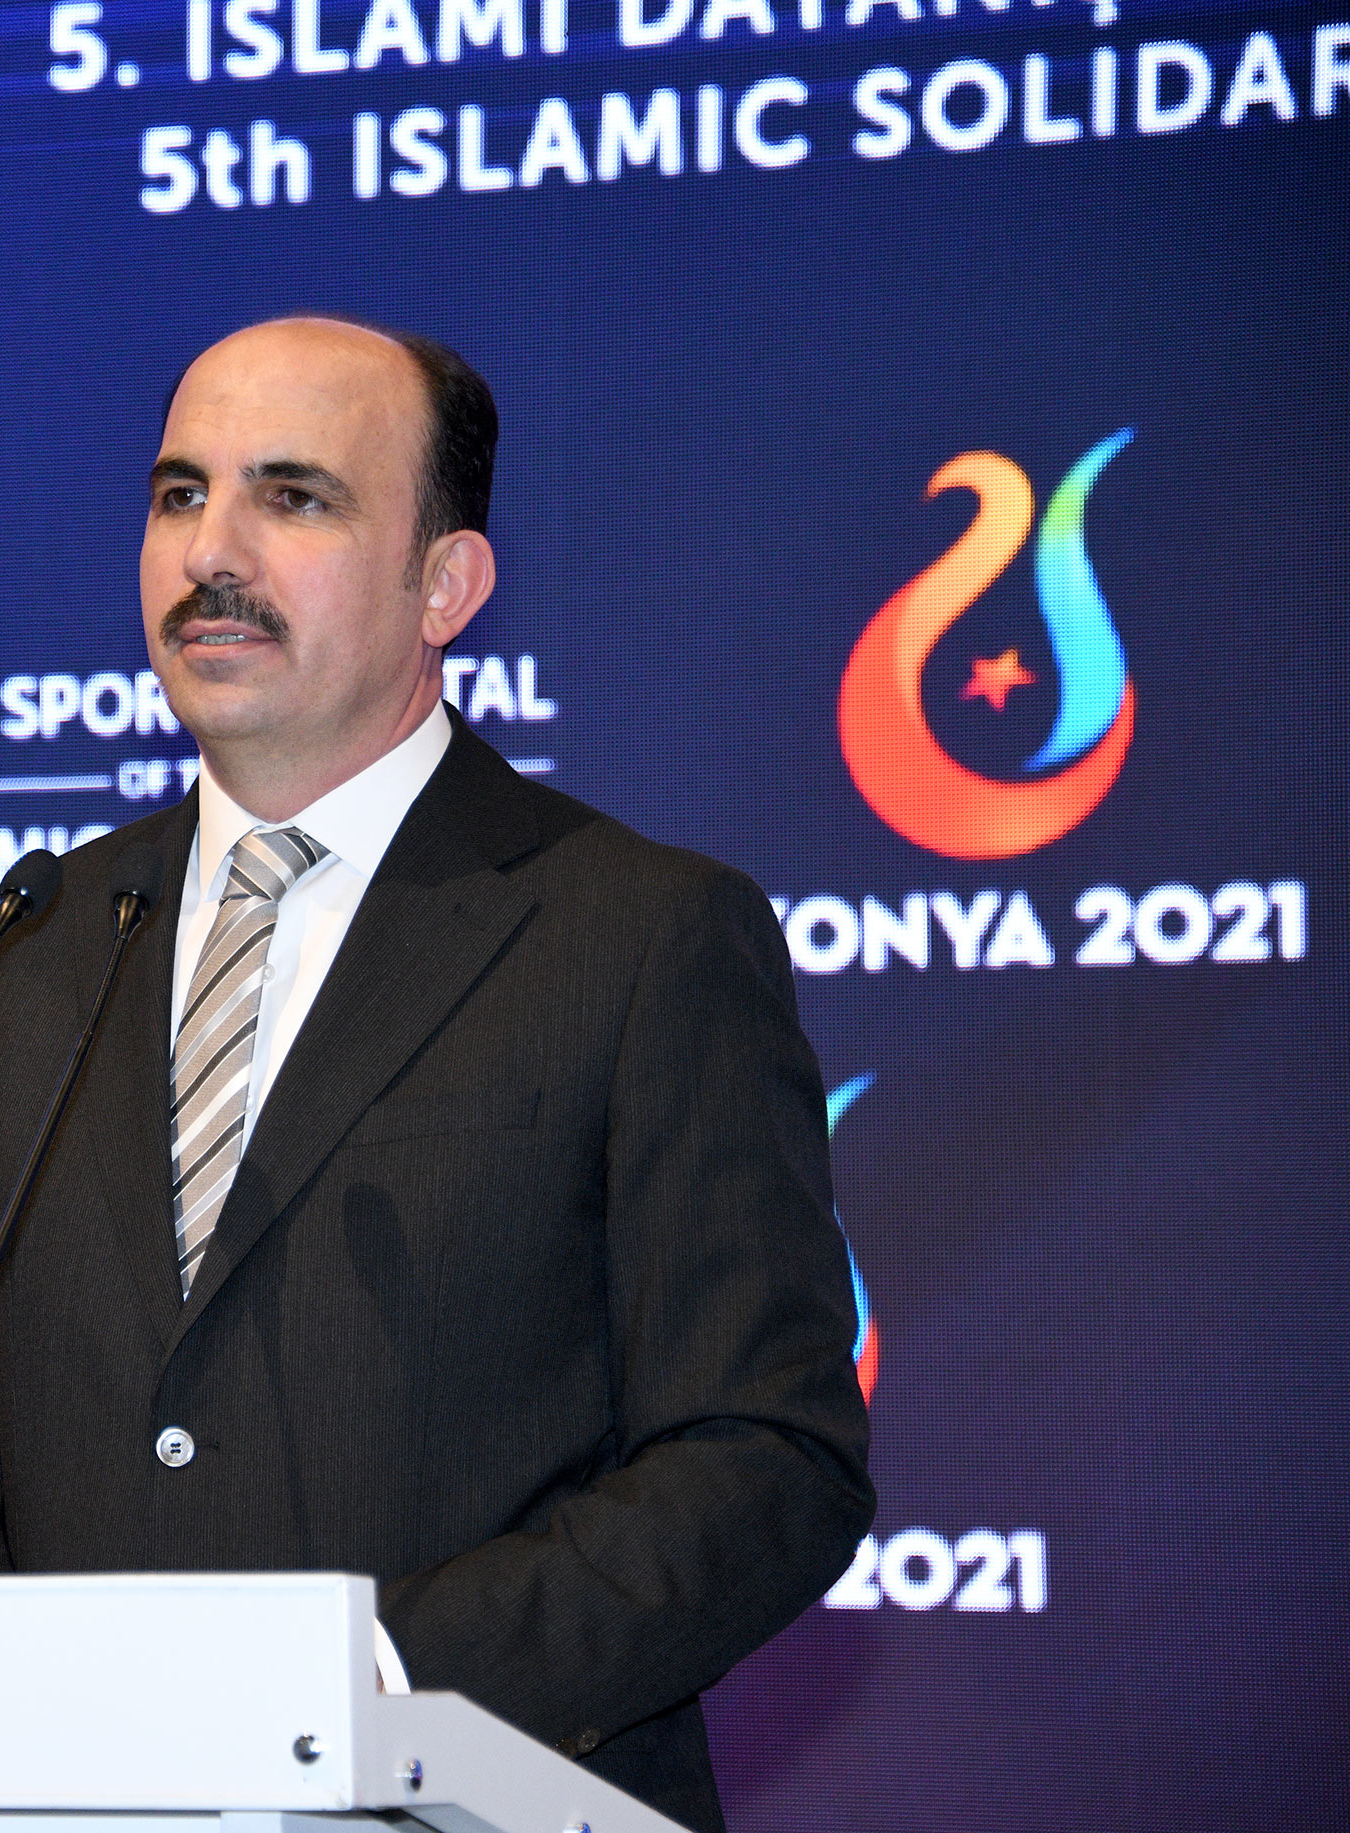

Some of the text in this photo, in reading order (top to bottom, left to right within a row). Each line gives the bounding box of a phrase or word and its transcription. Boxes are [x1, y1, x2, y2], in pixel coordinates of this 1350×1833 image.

[48, 1, 140, 92] 5.
[139, 119, 311, 213] 5th
[352, 76, 810, 199] ISLAMIC
[769, 878, 1309, 975] ONYA 2021
[824, 1525, 1049, 1614] 2021
